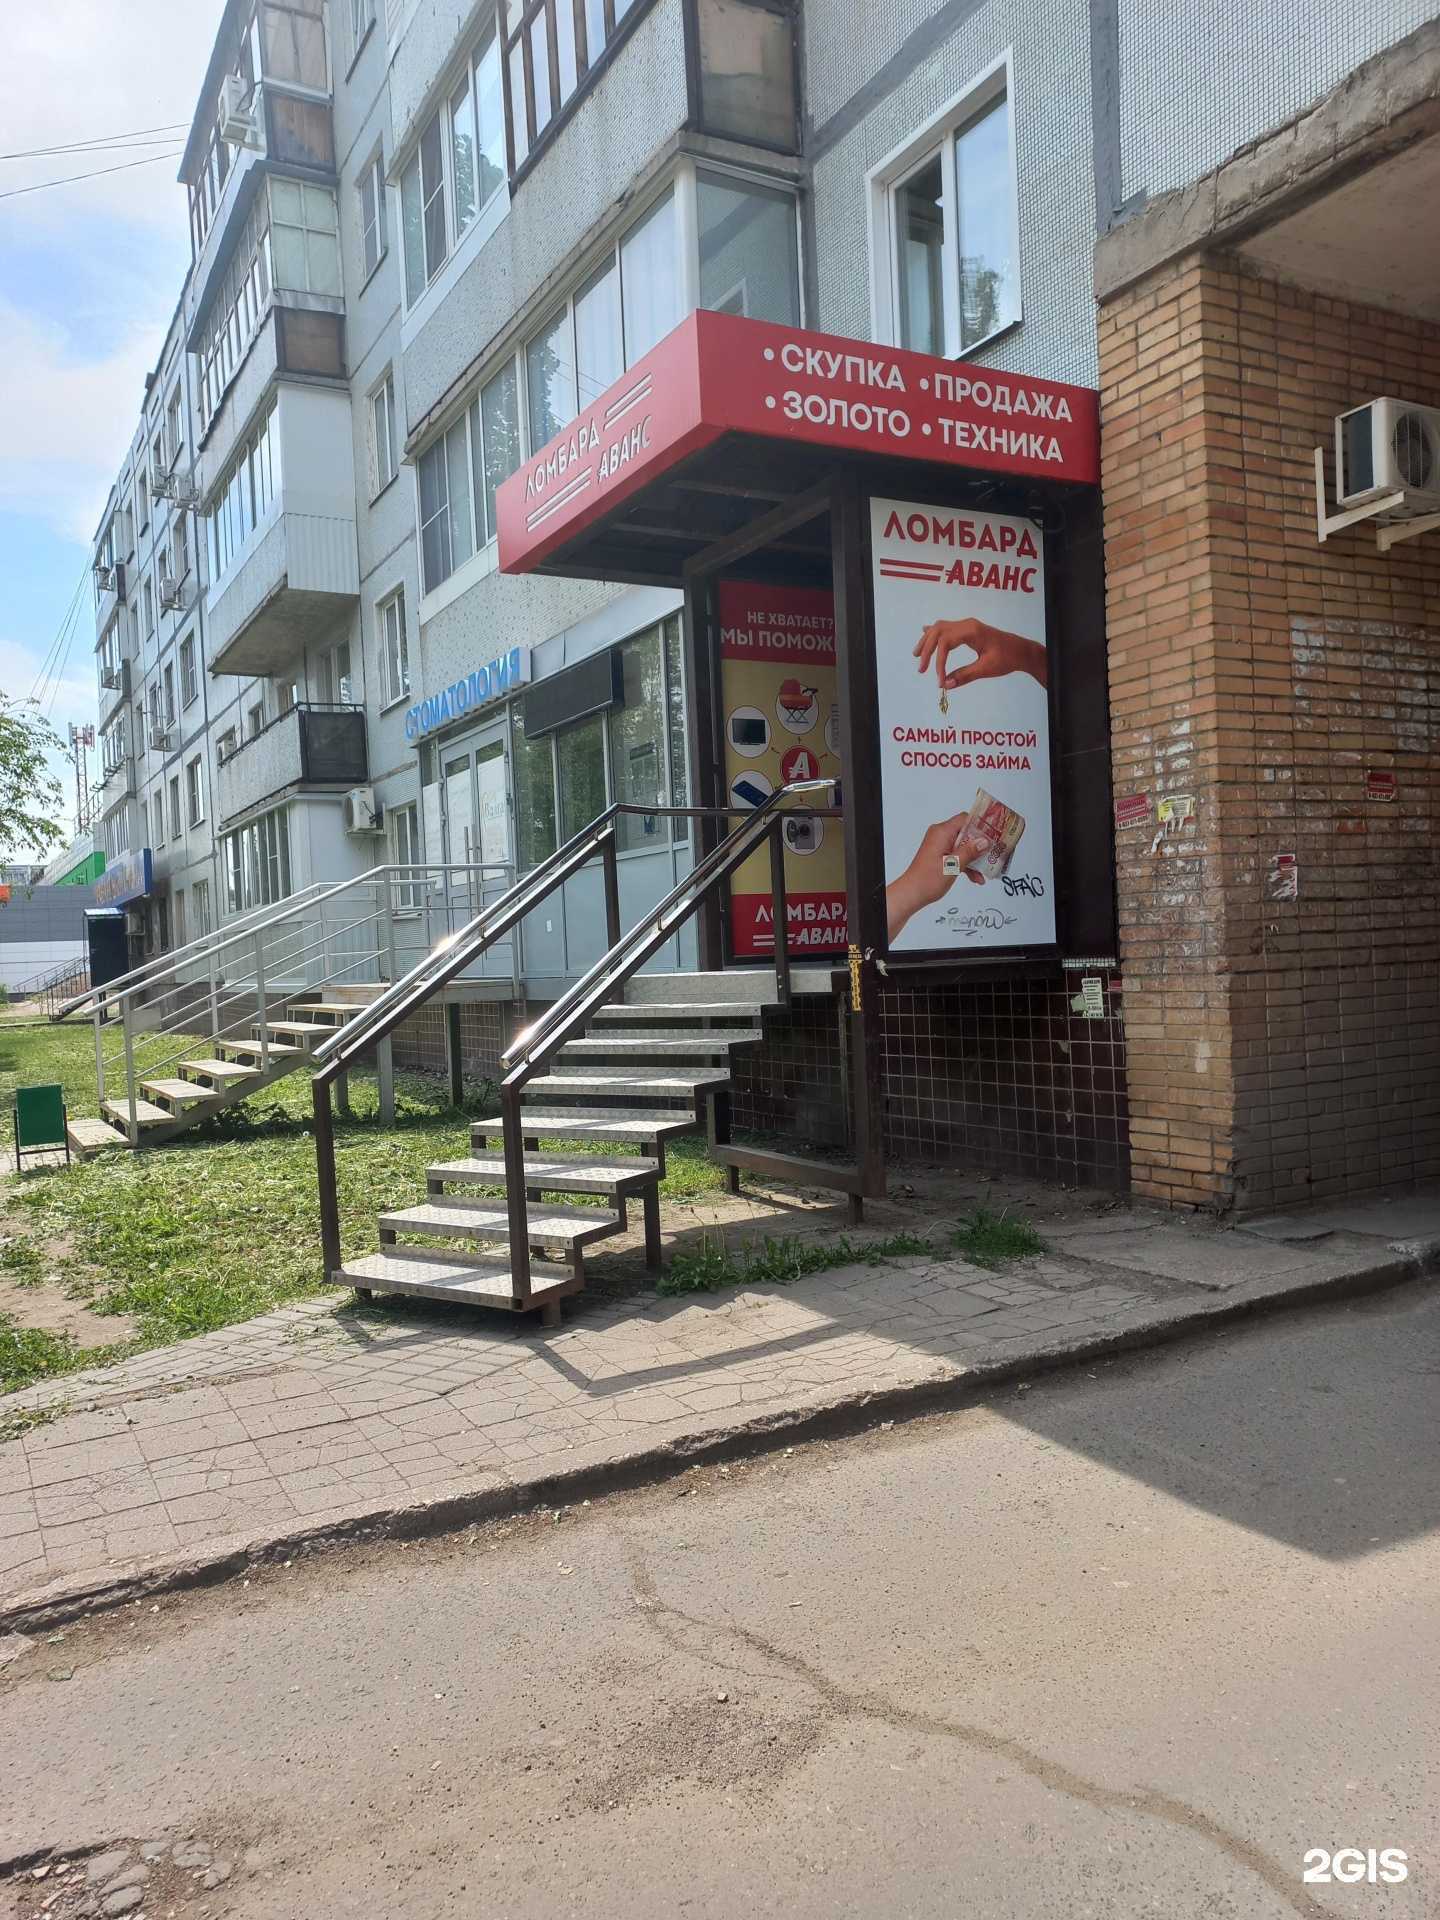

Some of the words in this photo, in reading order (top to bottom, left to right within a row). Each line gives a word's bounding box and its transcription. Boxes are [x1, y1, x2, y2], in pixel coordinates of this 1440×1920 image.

[781, 344, 906, 392] СКУПКА
[934, 373, 1073, 422] ПРОДАЖА
[783, 390, 911, 437] ЗОЛОТО
[938, 417, 1064, 463] ТЕХНИКА
[525, 417, 600, 503] ЛОМБАРД
[597, 414, 652, 484] АВАНС
[883, 510, 1038, 560] ЛОМБАРД
[945, 559, 1038, 593] АВАНС
[747, 610, 765, 624] НЕ
[768, 613, 834, 630] ХВАТАЕТ?
[720, 628, 753, 646] МЫ
[759, 630, 835, 652] ПОМОЖ
[405, 646, 521, 740] СТОМАТОЛОГИЯ
[893, 726, 957, 744] САМЫЙ
[961, 730, 1037, 747] ПРОСТОЙ
[901, 752, 972, 768] СПОСОБ
[976, 752, 1031, 770] ЗАЙМА
[755, 902, 848, 922] ЛМБАР
[797, 927, 848, 945] АВАН
